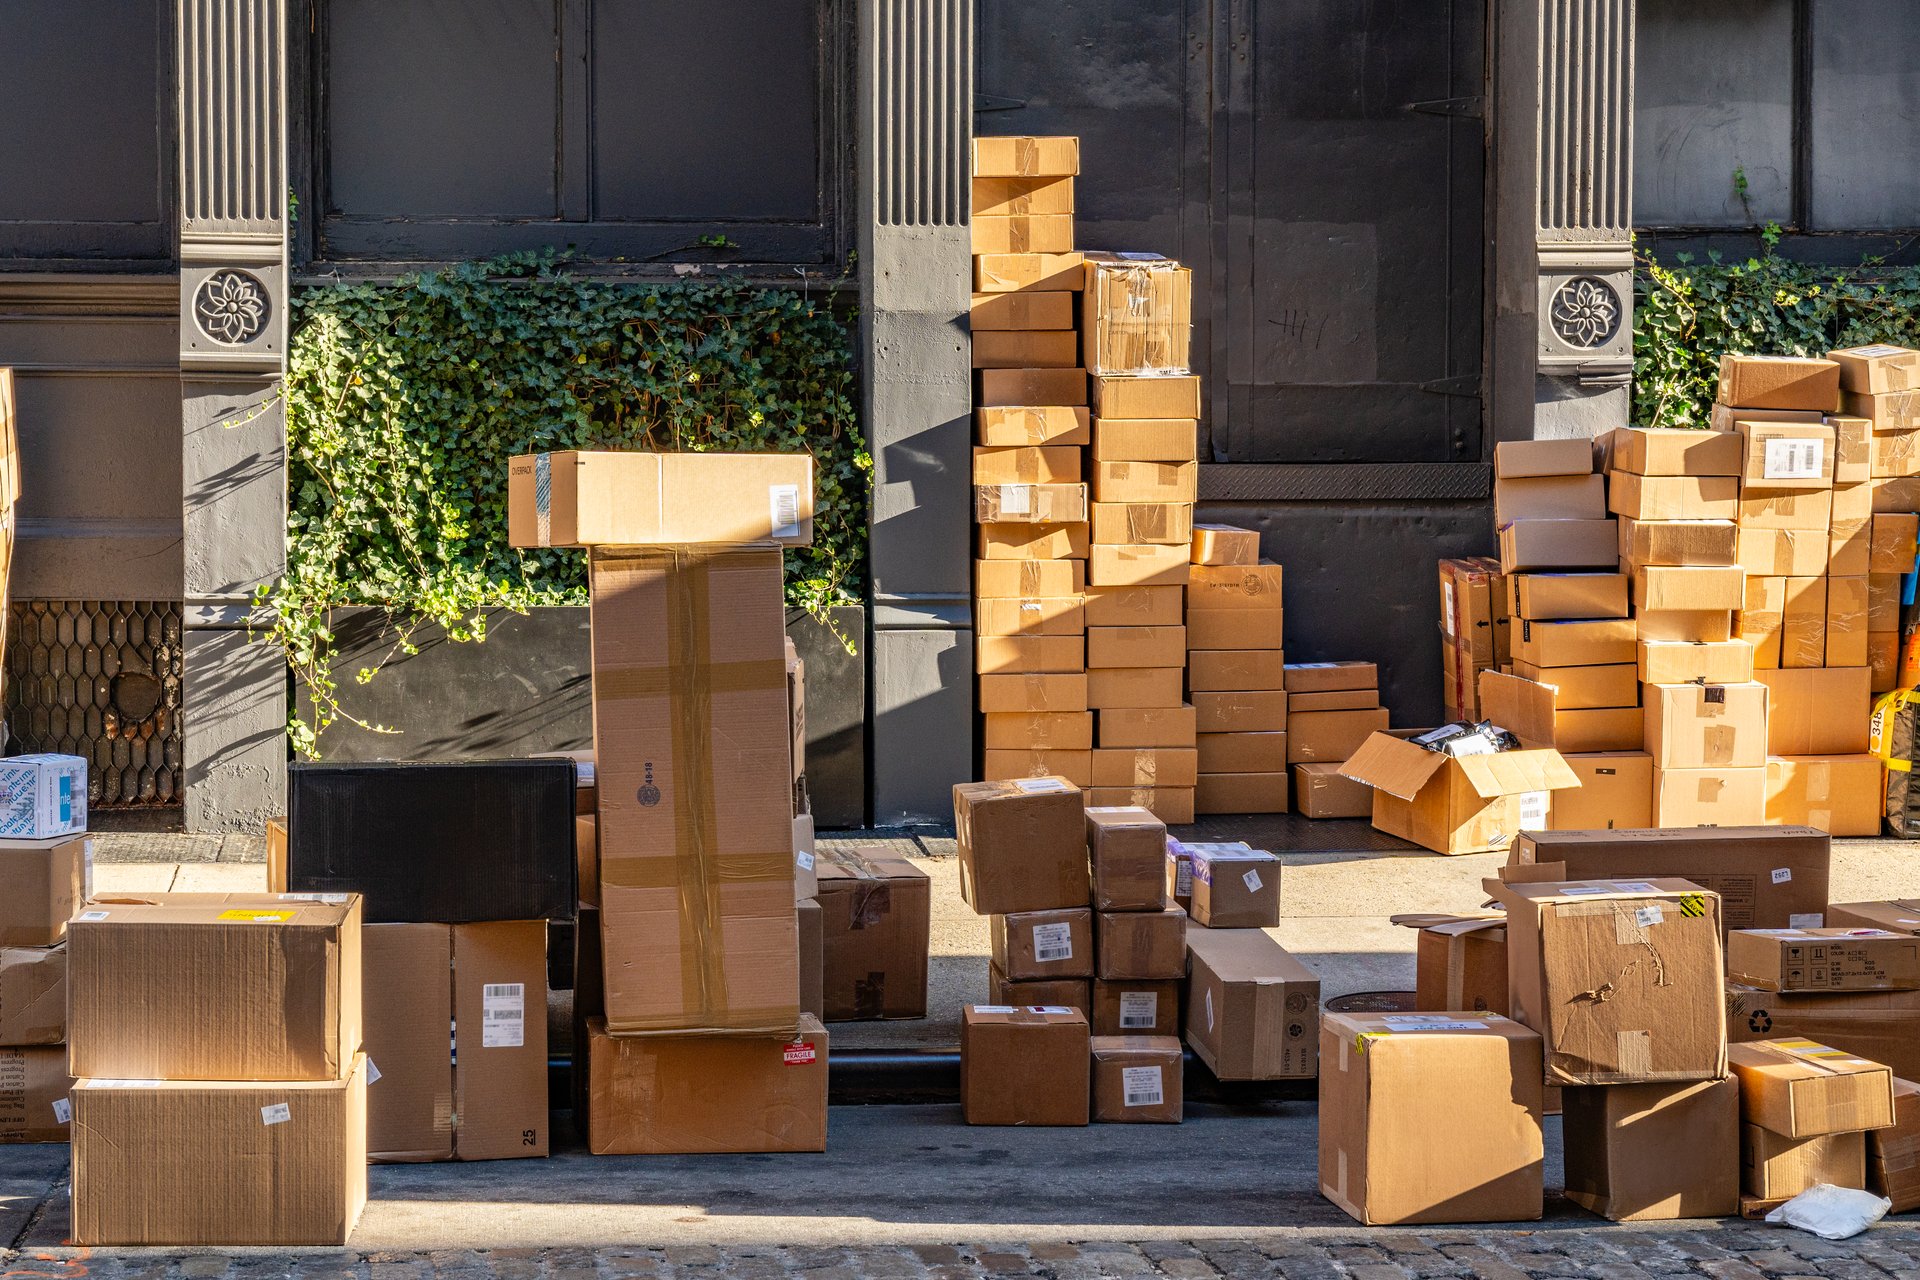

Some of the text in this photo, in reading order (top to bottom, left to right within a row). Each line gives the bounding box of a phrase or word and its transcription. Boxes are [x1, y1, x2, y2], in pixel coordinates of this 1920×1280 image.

[511, 466, 532, 476] OVERPACK
[1872, 712, 1883, 735] 348
[644, 762, 653, 784] 48-18
[1682, 897, 1700, 914] HEAVY
[786, 1051, 812, 1060] FRAGILE
[522, 1129, 535, 1146] 25
